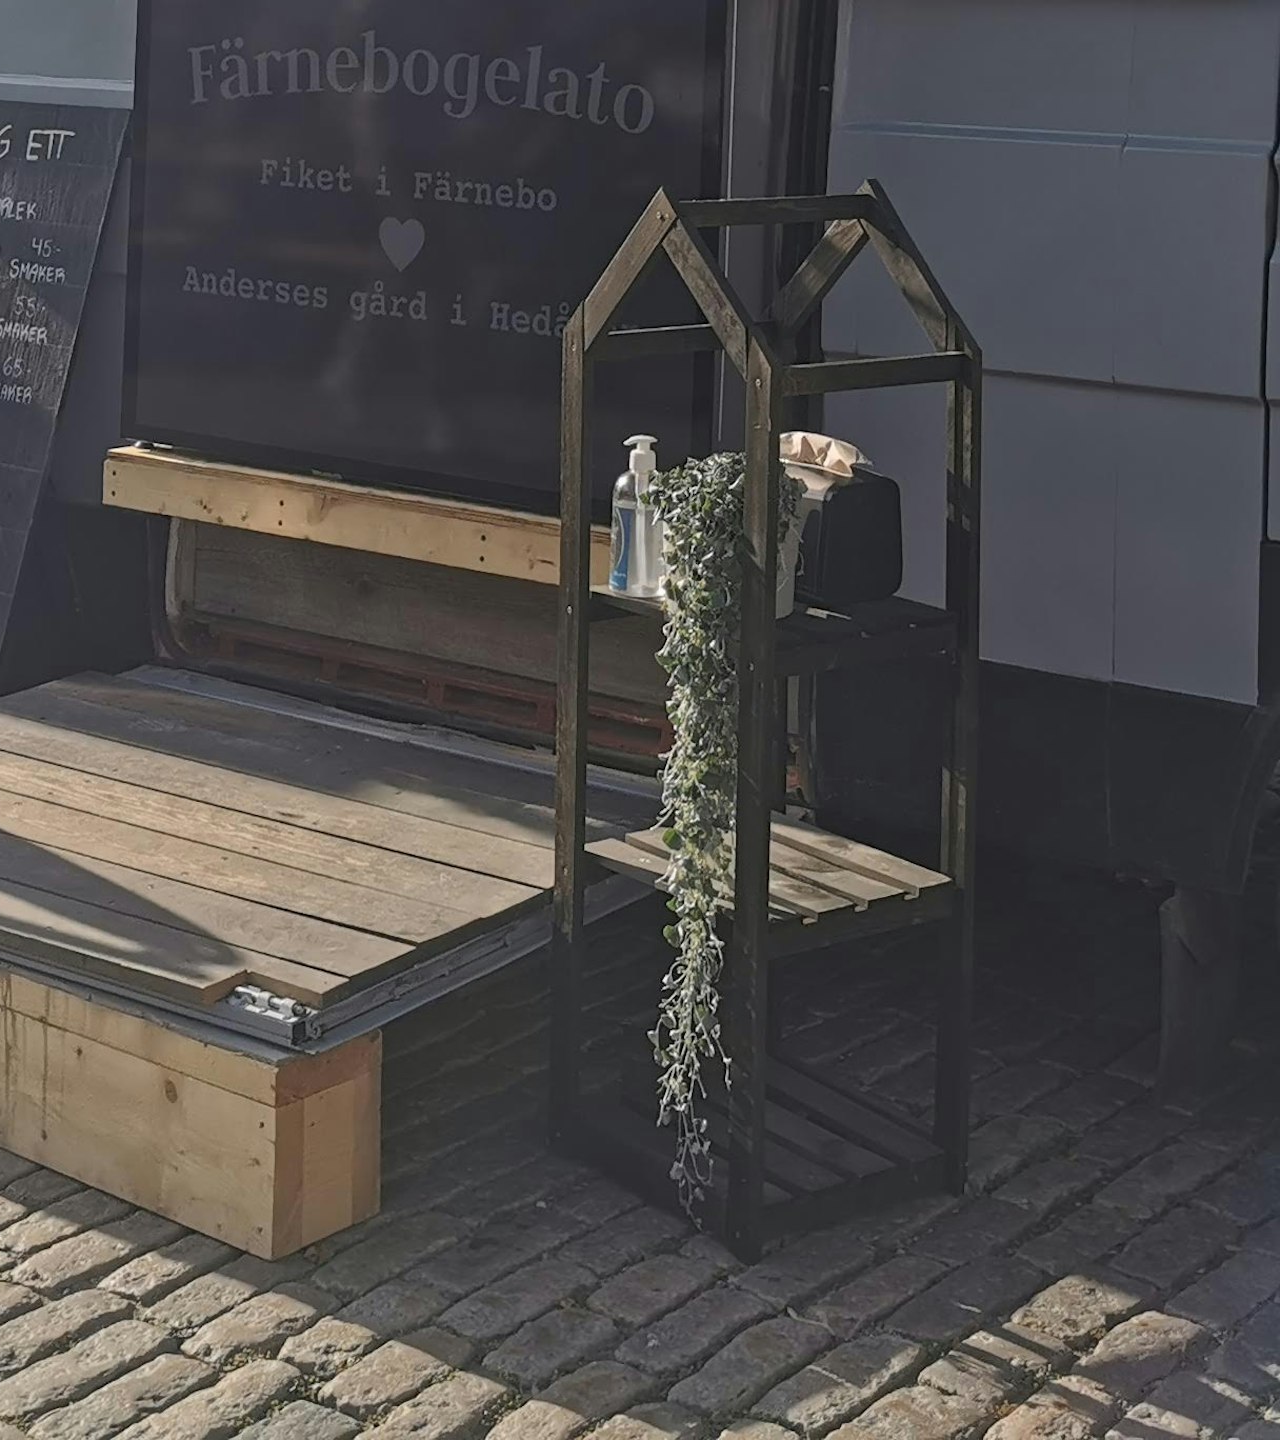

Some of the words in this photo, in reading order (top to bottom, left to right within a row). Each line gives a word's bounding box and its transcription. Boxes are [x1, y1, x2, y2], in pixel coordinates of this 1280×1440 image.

[187, 31, 654, 134] Färnebogelato
[26, 129, 75, 161] ETT
[259, 159, 352, 193] Fiket
[375, 166, 391, 196] i
[414, 172, 558, 212] Färnebo
[10, 259, 66, 284] SMAKER
[182, 267, 328, 310] Anderses
[350, 279, 428, 322] gård
[450, 296, 467, 327] i
